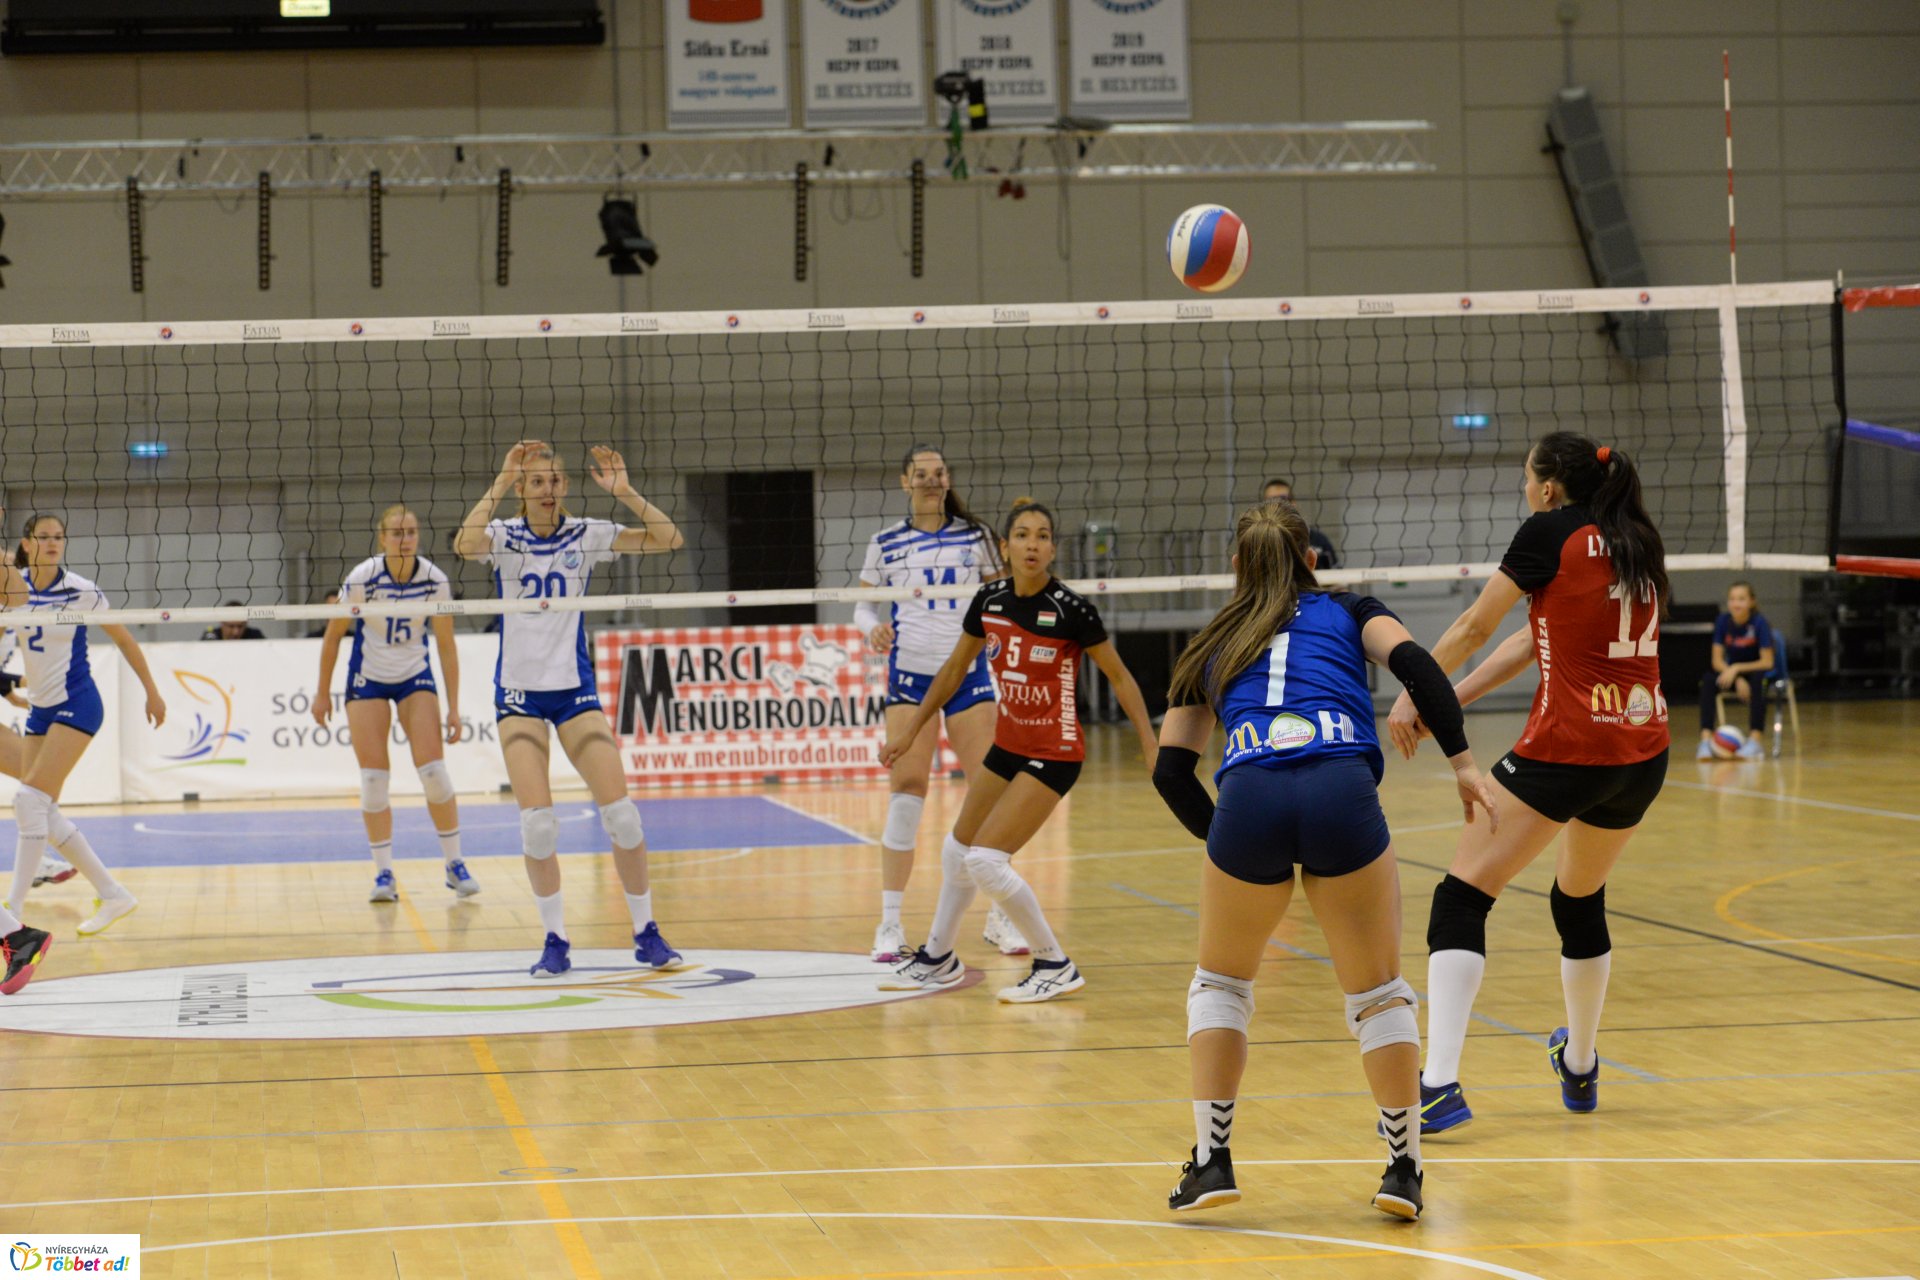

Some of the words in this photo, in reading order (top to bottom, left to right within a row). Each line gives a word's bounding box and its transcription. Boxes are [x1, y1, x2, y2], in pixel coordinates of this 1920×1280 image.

[1177, 303, 1213, 315] FATUM
[1358, 299, 1394, 311] FATUM
[808, 312, 845, 323] FATUM
[993, 308, 1030, 319] FATUM
[243, 324, 281, 335] FATUM
[433, 320, 471, 331] FATUM
[621, 316, 658, 328] FATUM
[52, 327, 90, 338] FATUM
[521, 571, 567, 613] 20
[923, 568, 956, 610] 14
[385, 616, 411, 644] 15
[1006, 635, 1022, 668] 5
[898, 673, 914, 687] 14
[504, 689, 526, 705] 20
[620, 645, 763, 735] MARCI
[1000, 681, 1052, 704] ATUM
[1058, 657, 1078, 741] NYÍREGYHÁZA
[1501, 757, 1516, 774] JAKO
